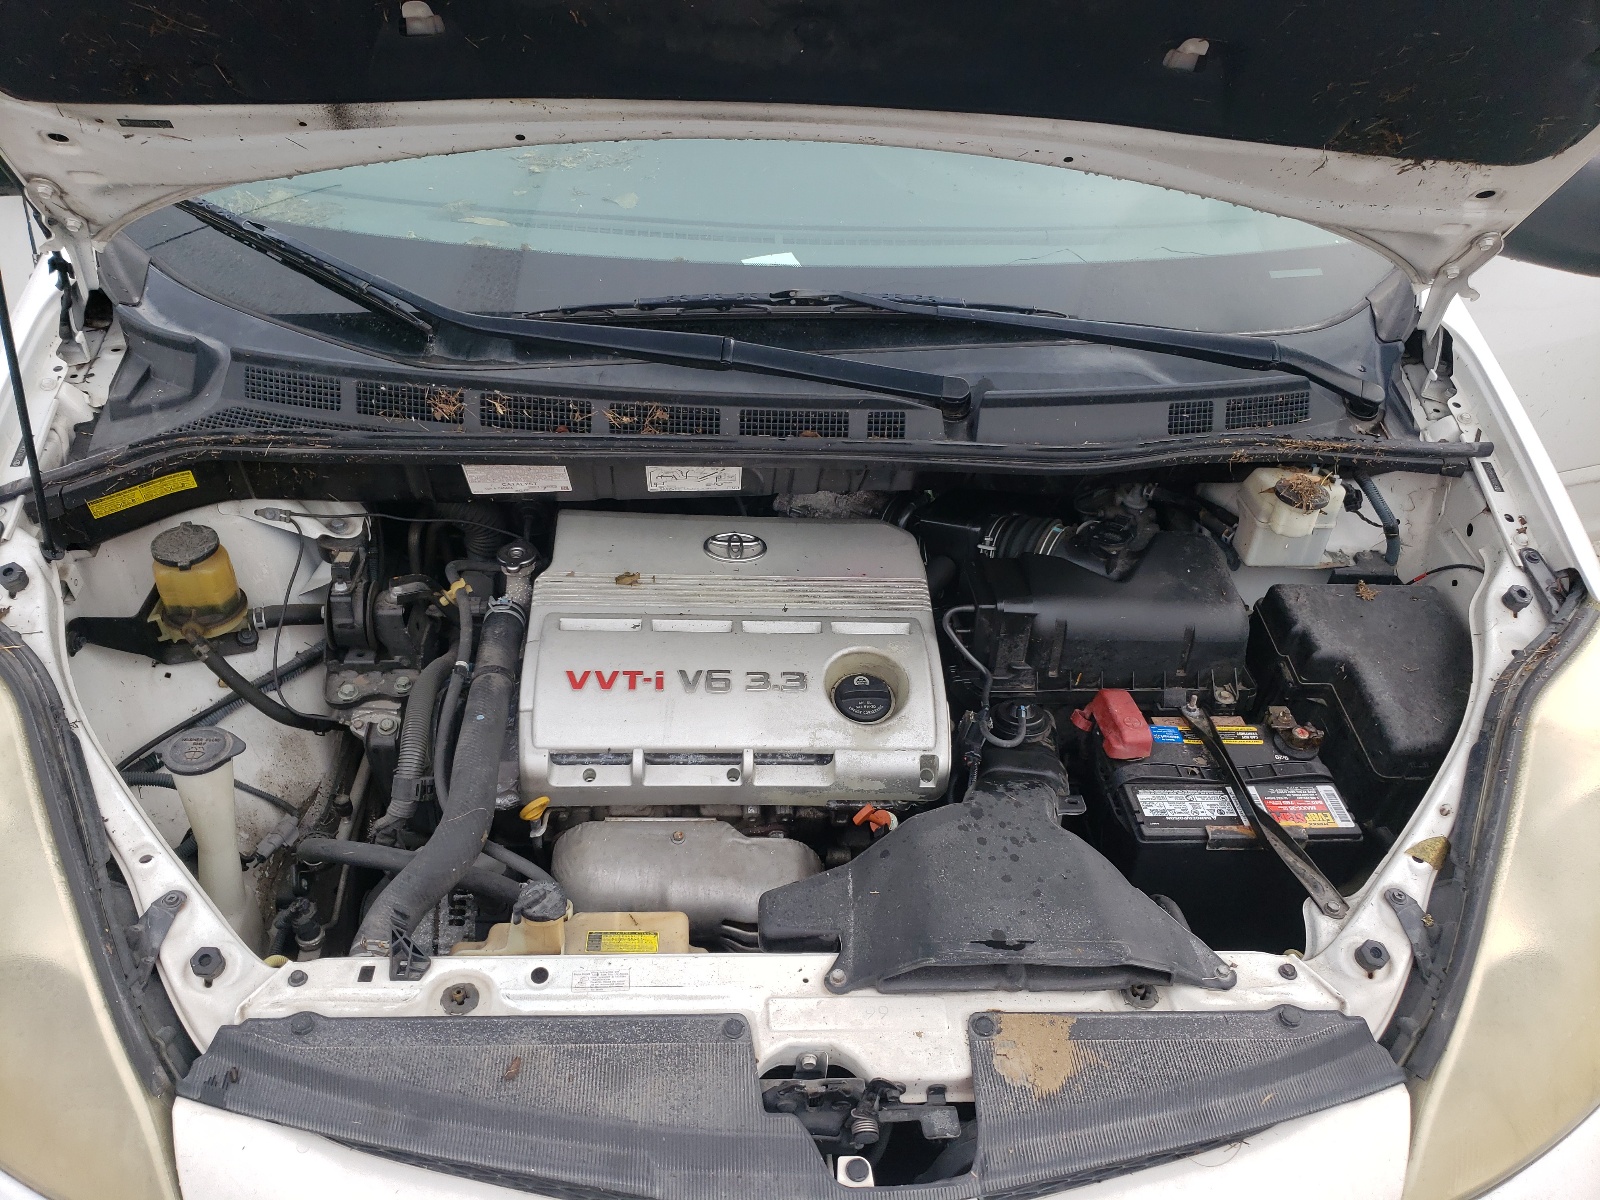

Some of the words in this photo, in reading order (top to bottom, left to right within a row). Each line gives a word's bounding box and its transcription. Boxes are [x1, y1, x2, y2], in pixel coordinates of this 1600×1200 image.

[566, 670, 665, 692] VVT-i
[678, 669, 732, 693] V6
[745, 670, 808, 693] 3.3
